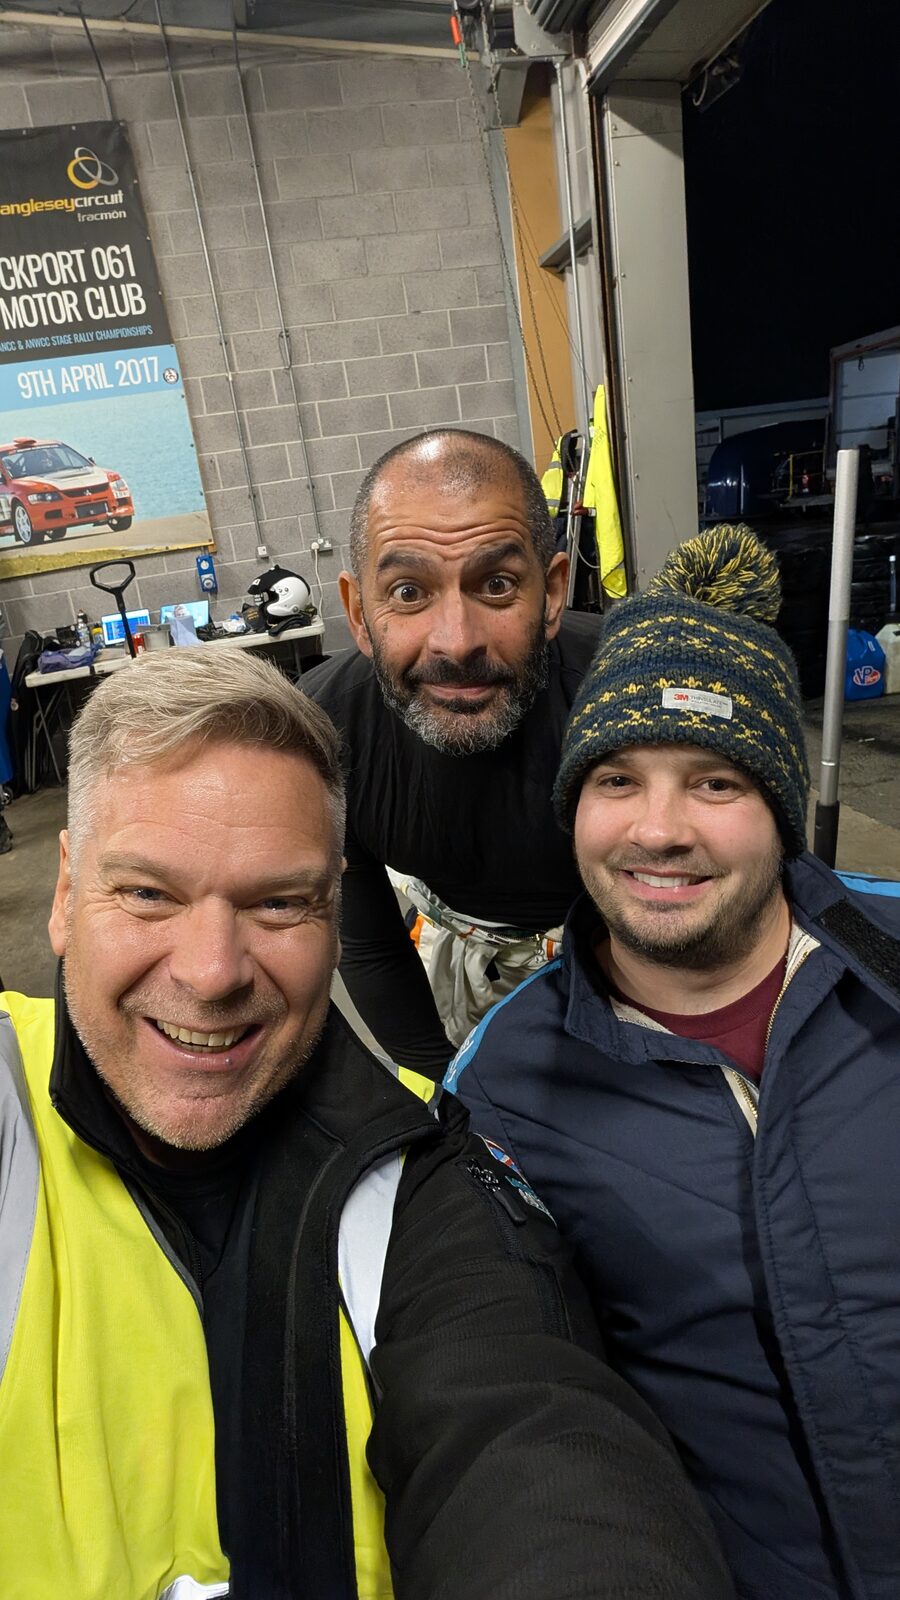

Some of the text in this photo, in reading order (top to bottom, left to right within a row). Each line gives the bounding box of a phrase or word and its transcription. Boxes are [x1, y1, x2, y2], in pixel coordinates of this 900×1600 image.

[0, 244, 136, 290] CKPORT 061
[0, 283, 147, 330] MOTOR CLUB
[17, 340, 25, 350] &
[25, 336, 51, 349] ANWCC
[51, 334, 73, 346] STAGE
[73, 331, 94, 344] RALLY
[95, 325, 154, 341] CHAMPIONSHIPS
[17, 356, 159, 399] 9TH APRIL 2017
[854, 666, 874, 686] VP
[673, 693, 689, 702] 3M
